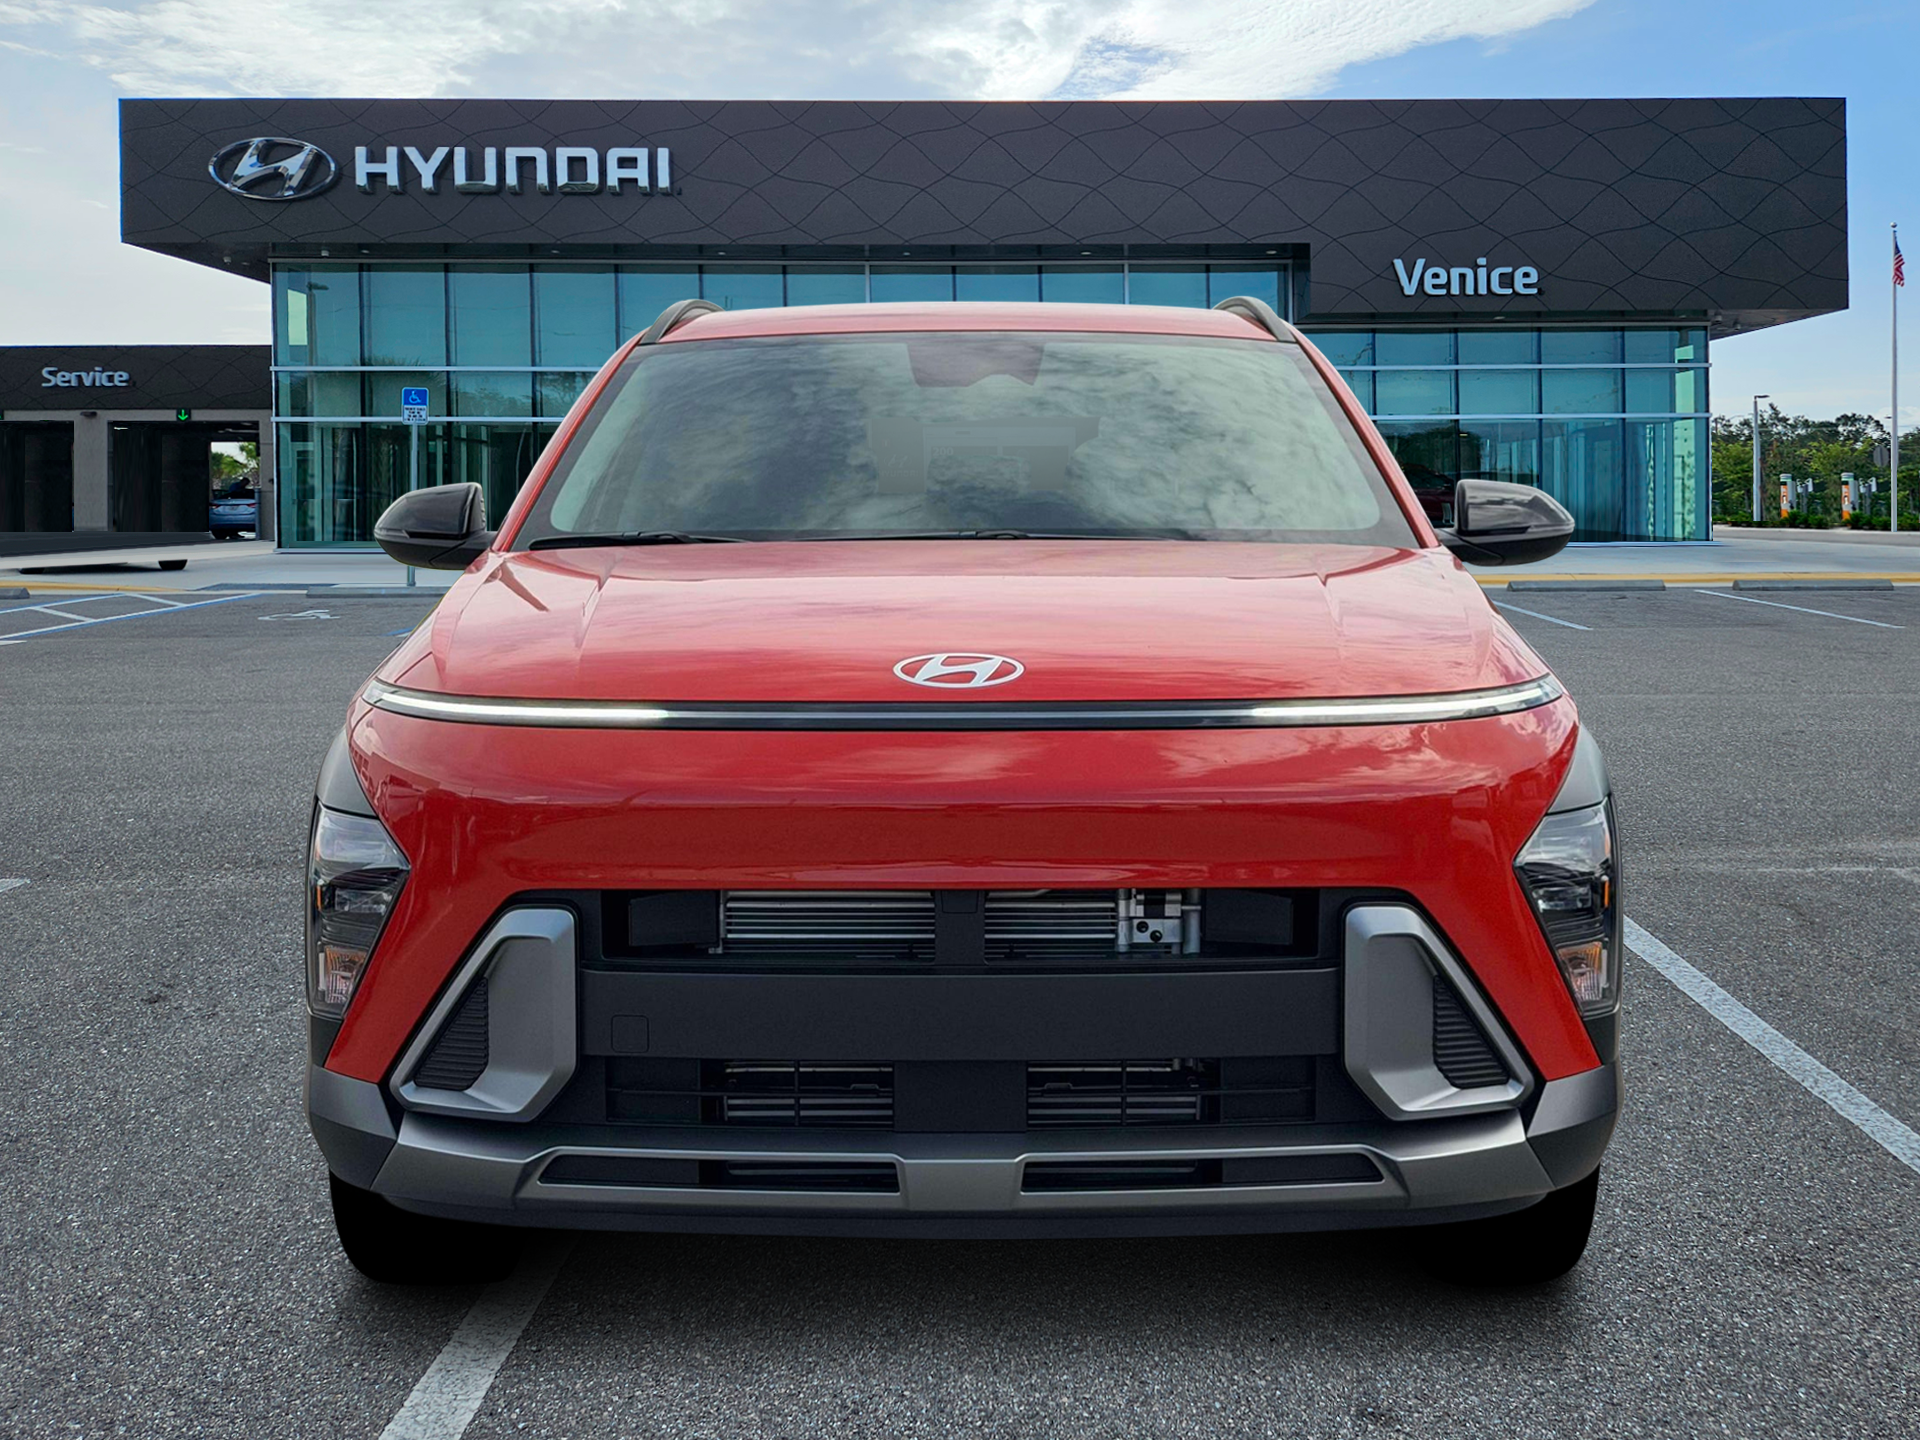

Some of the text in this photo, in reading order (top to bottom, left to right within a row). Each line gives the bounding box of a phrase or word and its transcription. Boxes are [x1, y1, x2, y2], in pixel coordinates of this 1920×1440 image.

[354, 146, 672, 195] HYUNDAI
[1393, 257, 1539, 296] Venice
[41, 366, 130, 387] Service
